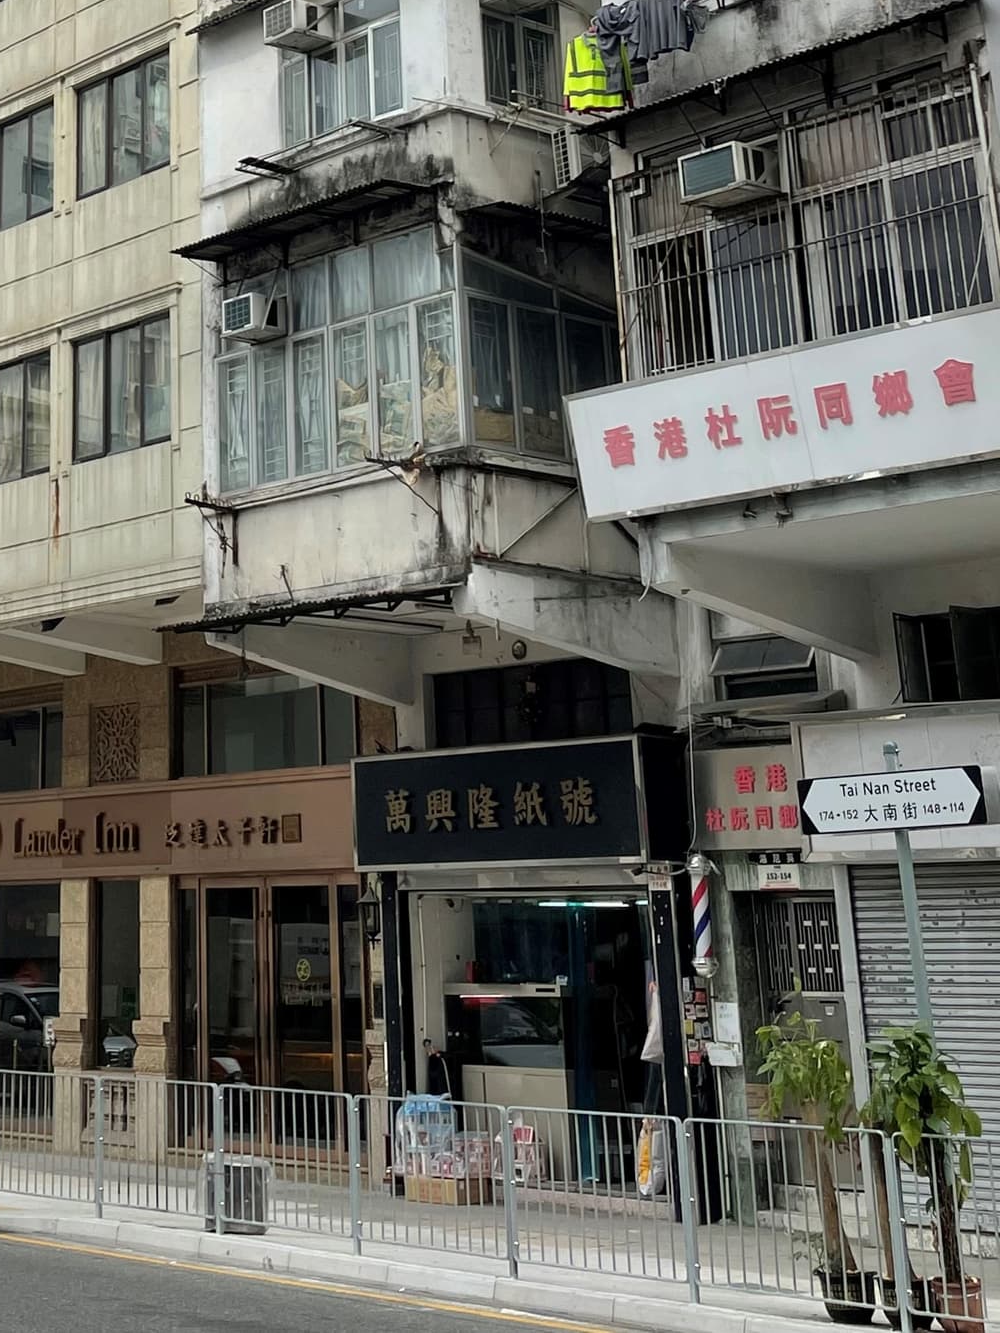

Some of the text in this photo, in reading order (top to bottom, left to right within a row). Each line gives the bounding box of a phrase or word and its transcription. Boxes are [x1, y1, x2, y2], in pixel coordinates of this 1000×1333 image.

[603, 358, 977, 469] 香港杜阮同鄉會
[734, 763, 788, 794] 香港
[840, 777, 936, 798] Tai Nan Street
[384, 777, 598, 834] 萬興隆紙號
[864, 802, 917, 823] 大南街
[14, 811, 139, 858] Lander Inn
